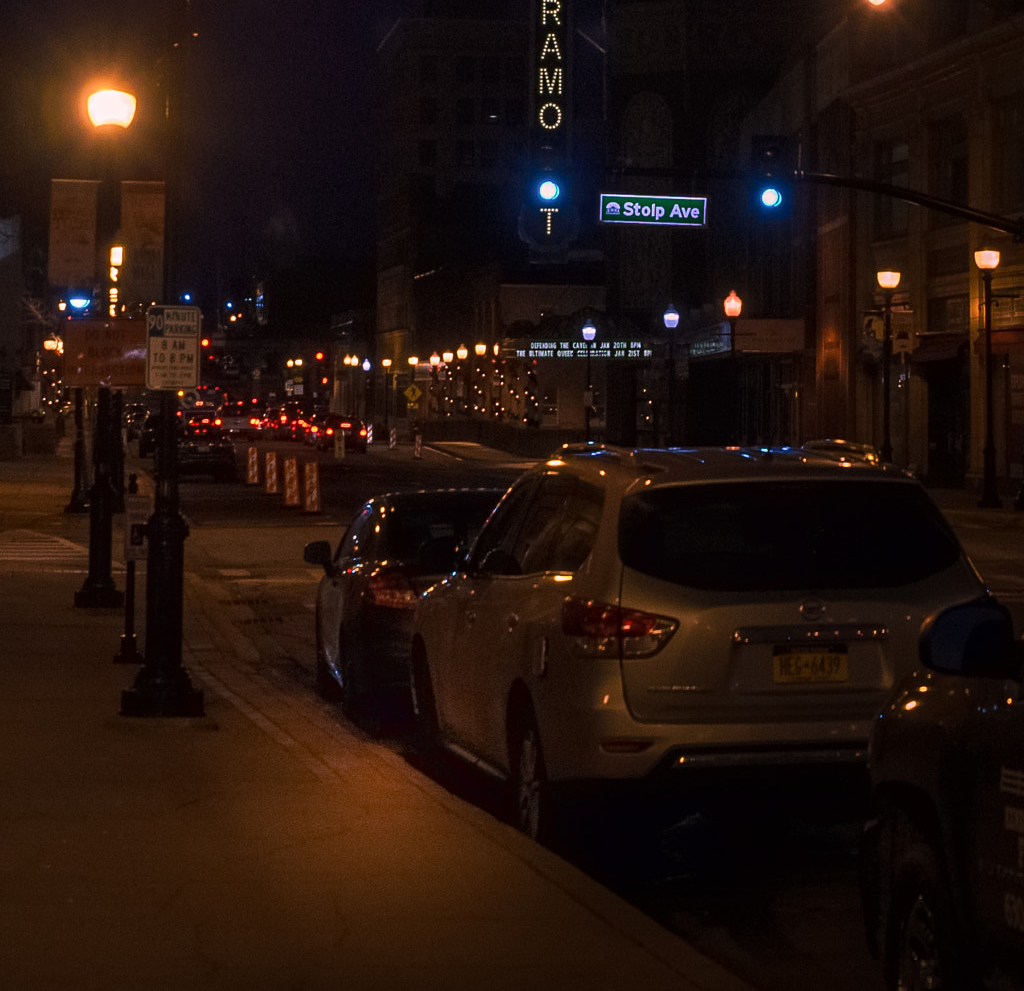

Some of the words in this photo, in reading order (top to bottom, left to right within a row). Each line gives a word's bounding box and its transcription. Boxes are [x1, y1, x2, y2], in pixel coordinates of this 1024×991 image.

[622, 201, 665, 221] Stolp
[669, 203, 700, 219] Ave
[149, 314, 164, 330] 90
[166, 311, 195, 322] MINUTE
[85, 329, 100, 340] DO
[105, 329, 125, 340] NOT
[166, 324, 197, 334] PARKING
[161, 340, 168, 350] 8
[171, 340, 186, 350] AM
[530, 341, 557, 349] DEFENDING
[559, 341, 569, 349] THE
[572, 341, 597, 349] CAVEAN
[599, 341, 610, 349] JAN
[613, 341, 627, 349] 20TH
[153, 353, 165, 363] TO
[179, 353, 194, 364] PM
[516, 349, 526, 357] THE
[528, 349, 554, 357] ULTIMATE
[614, 349, 625, 357] JAN
[628, 349, 640, 357] 21ST
